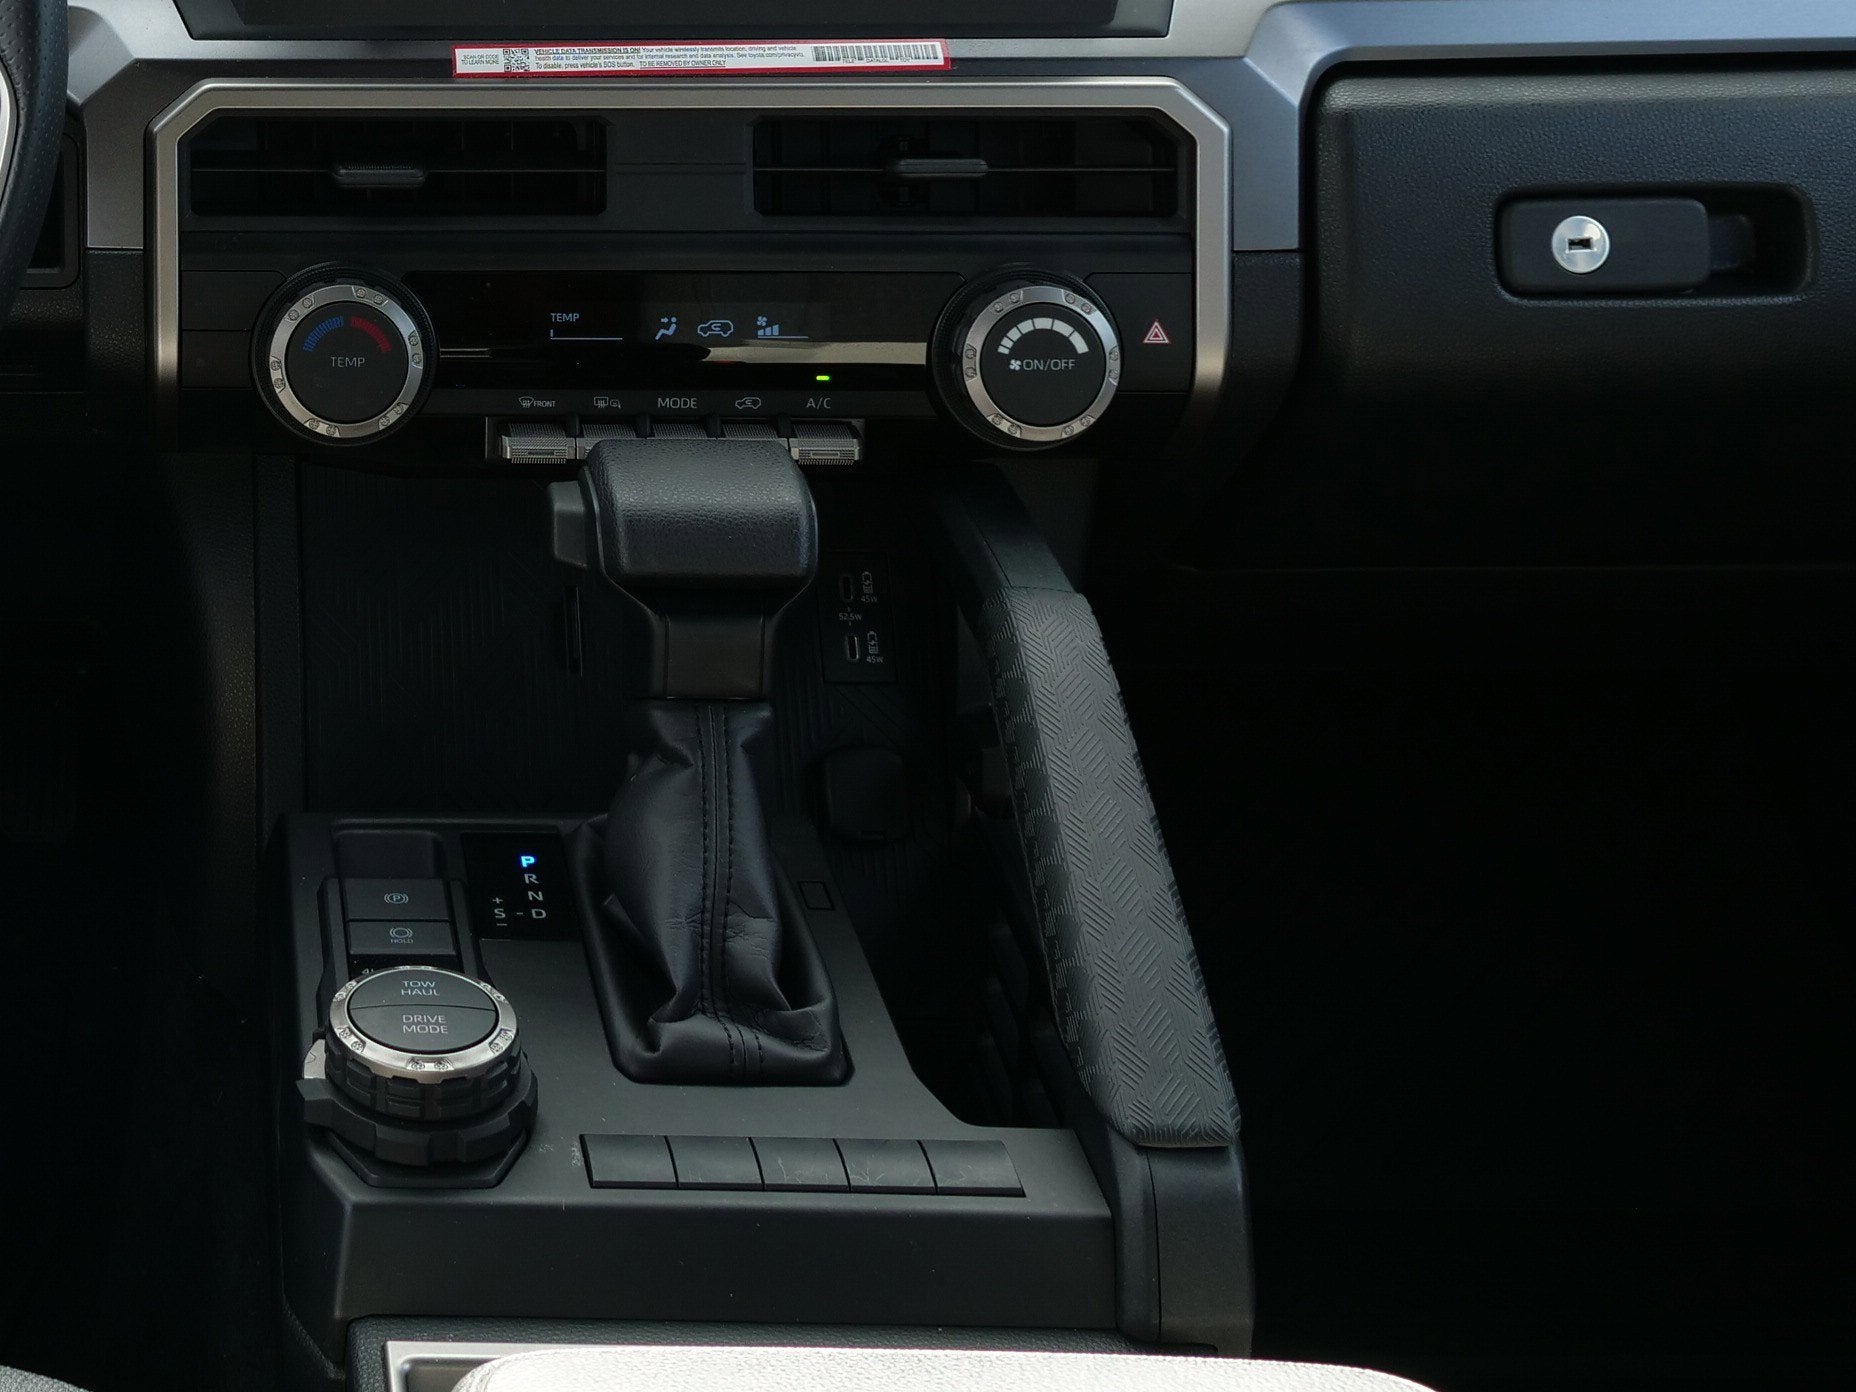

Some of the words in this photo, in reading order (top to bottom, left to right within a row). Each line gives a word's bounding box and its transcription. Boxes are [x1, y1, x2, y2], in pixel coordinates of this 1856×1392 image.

[550, 312, 580, 323] TEMP
[330, 356, 365, 368] TEMP
[1022, 358, 1076, 371] ON/OFF
[533, 399, 556, 408] FRONT
[657, 397, 698, 409] MODE
[806, 396, 832, 409] A/C
[866, 655, 884, 663] 45W
[521, 855, 535, 867] P
[524, 873, 539, 884] R
[527, 891, 543, 901] N
[494, 908, 506, 919] S
[531, 908, 547, 919] D
[402, 980, 436, 988] TOW
[400, 987, 440, 997] HAUL
[402, 1014, 447, 1024] DRIVE
[402, 1024, 448, 1034] MODE
